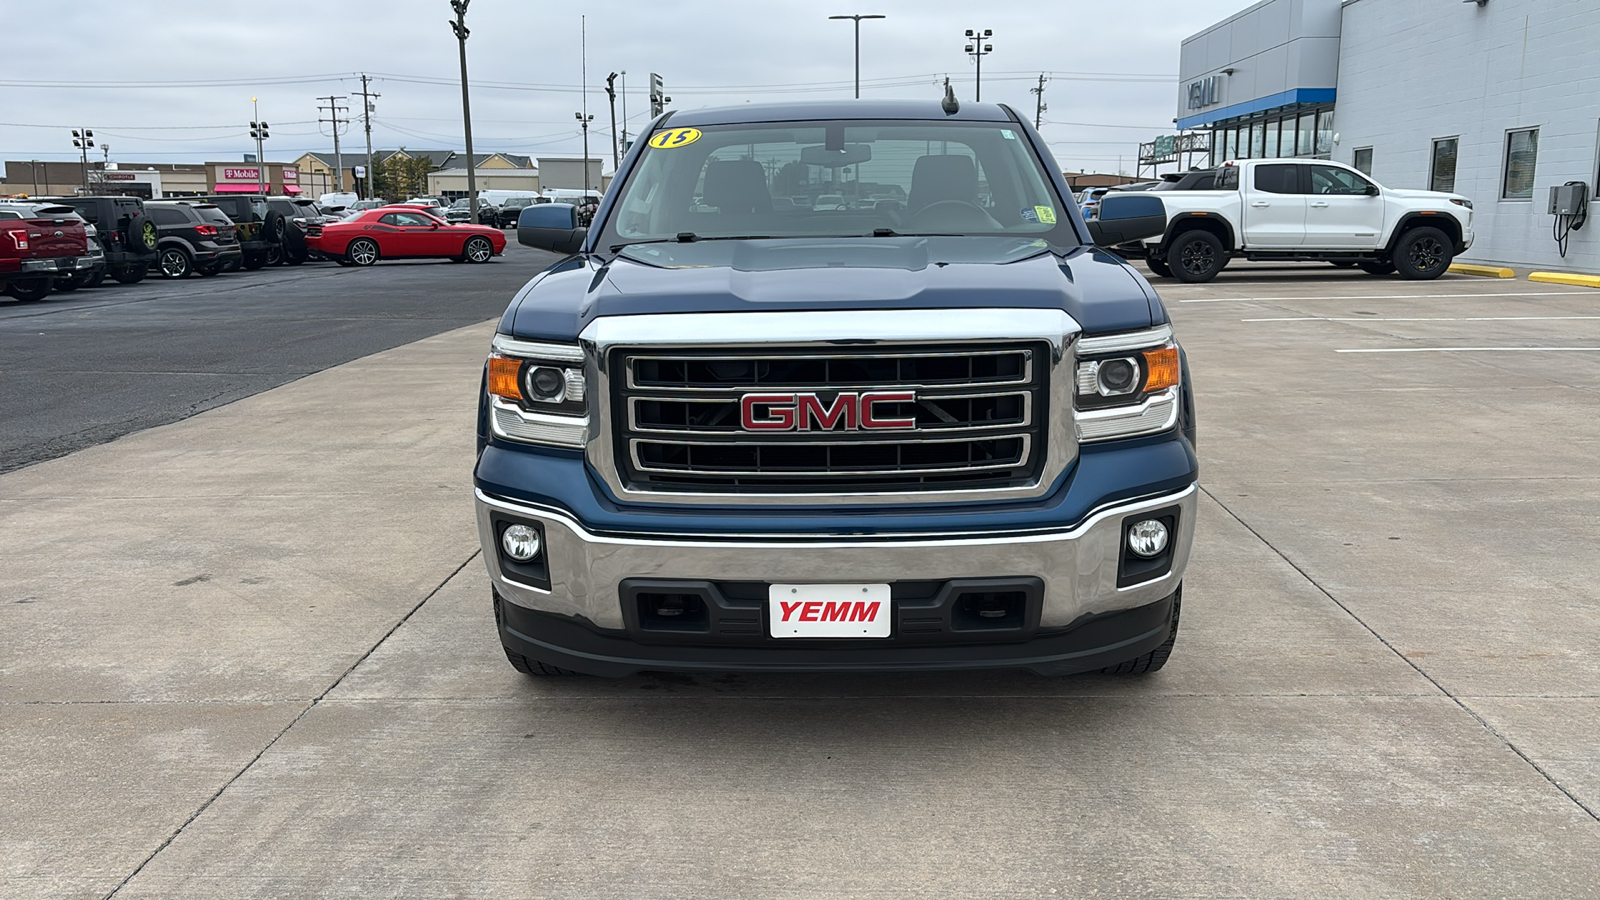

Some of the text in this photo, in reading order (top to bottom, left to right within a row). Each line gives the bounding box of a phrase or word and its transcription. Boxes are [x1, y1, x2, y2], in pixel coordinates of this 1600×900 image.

[659, 130, 691, 146] 15
[741, 391, 916, 431] GMC
[780, 602, 881, 622] YEMM
